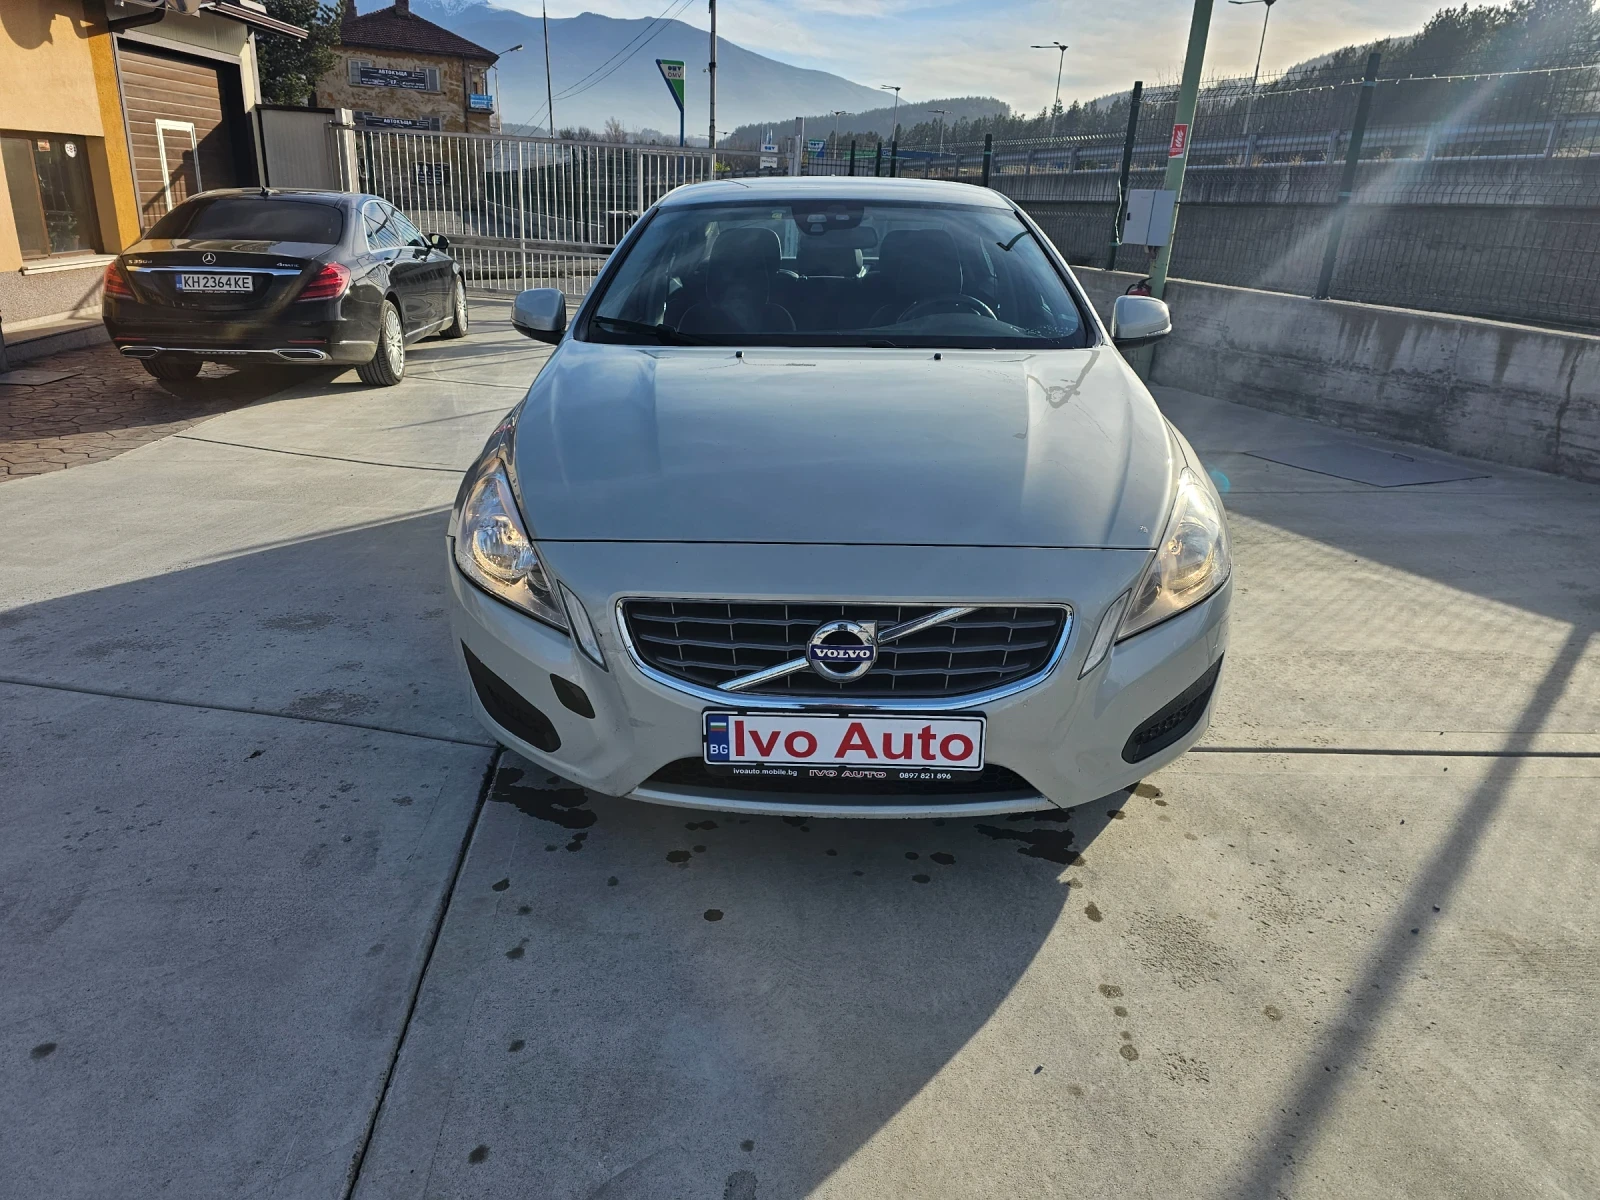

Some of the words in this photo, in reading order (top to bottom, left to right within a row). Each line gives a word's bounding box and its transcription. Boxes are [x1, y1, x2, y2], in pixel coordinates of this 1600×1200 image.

[813, 647, 871, 658] VOLVO
[734, 720, 818, 759] Ivo
[833, 721, 974, 762] Auto
[710, 744, 728, 755] BG
[808, 769, 838, 778] IVO
[841, 770, 887, 779] AUTO
[899, 772, 919, 780] 0897
[920, 772, 934, 780] 821
[936, 772, 952, 780] 896
